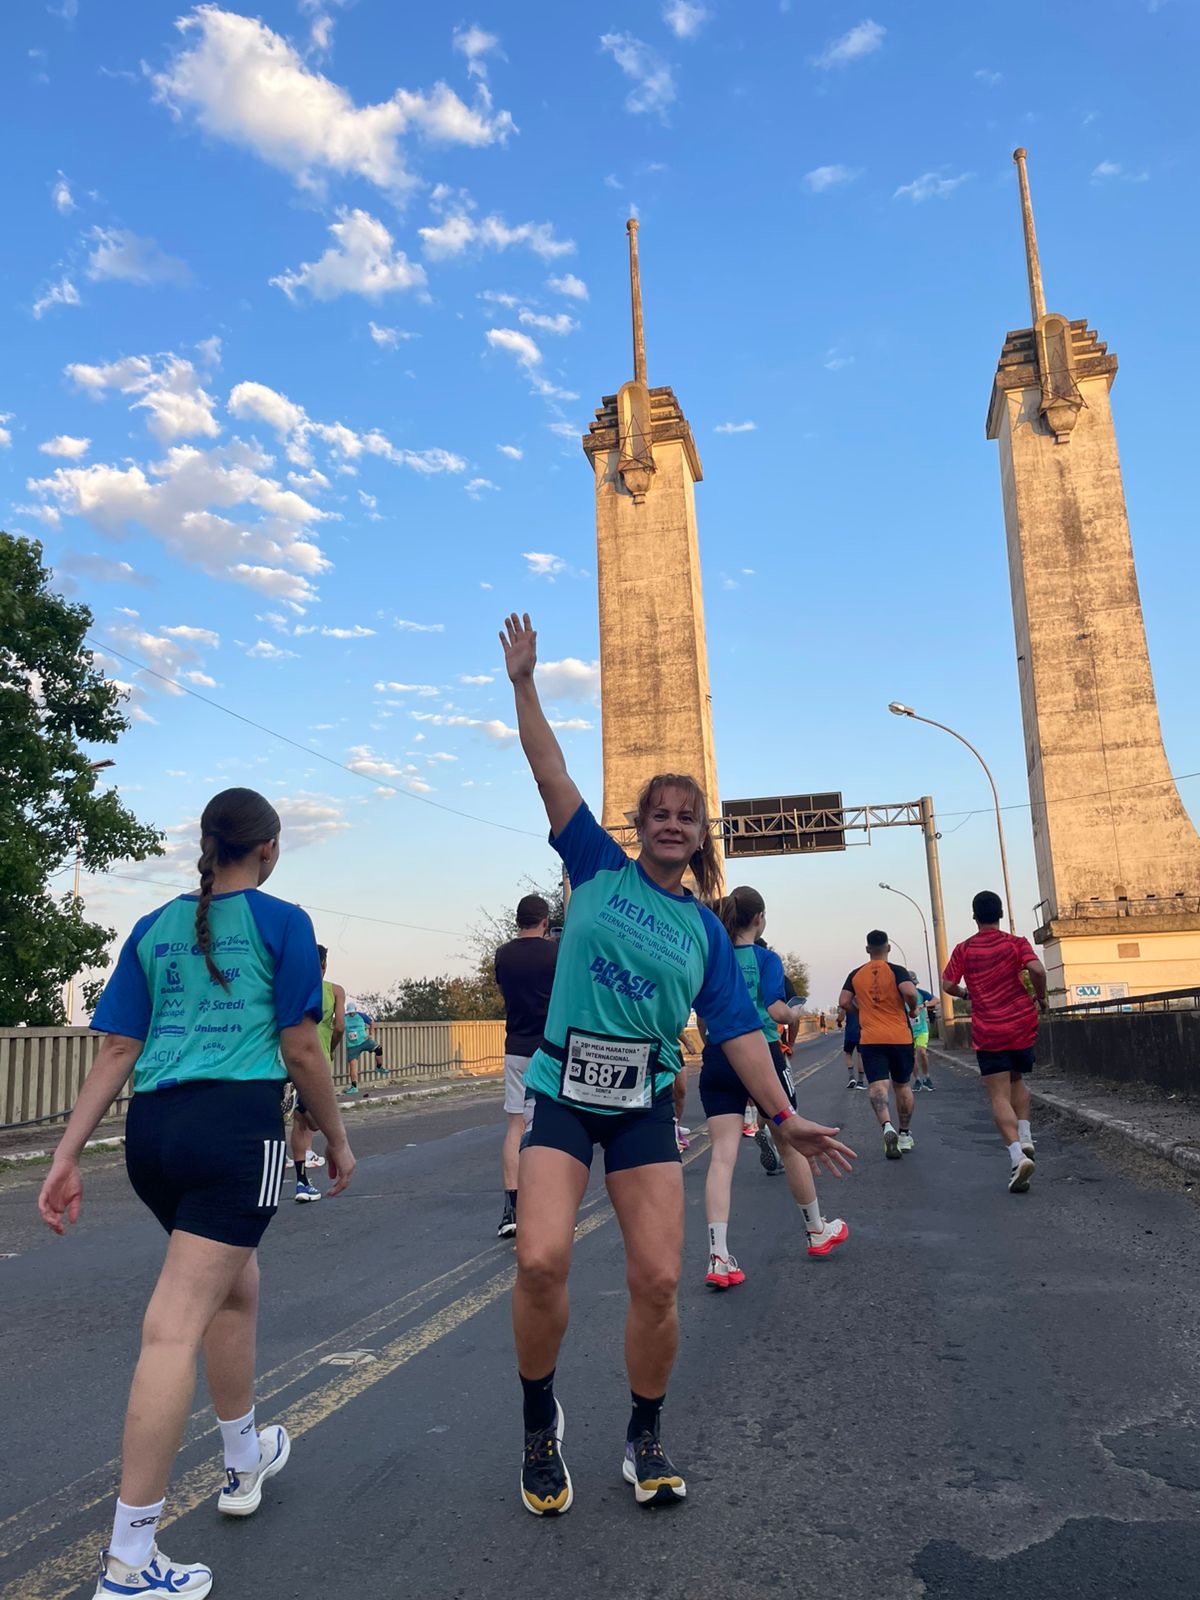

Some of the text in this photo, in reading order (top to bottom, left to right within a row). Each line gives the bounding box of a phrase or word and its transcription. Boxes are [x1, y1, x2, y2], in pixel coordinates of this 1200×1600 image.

[607, 894, 655, 932] MEIA
[598, 911, 687, 968] INTERNACIONAL URUGUAIANA
[656, 926, 678, 945] TONA
[170, 942, 188, 952] CDL
[590, 955, 657, 1000] BRASIL
[592, 973, 644, 1002] FREE SHOP
[1076, 986, 1100, 995] CVV
[194, 1024, 228, 1033] Unimed
[585, 1051, 630, 1062] INTERNACIONAL
[606, 1046, 637, 1054] MARATONA
[571, 1065, 579, 1074] 5K
[584, 1062, 627, 1089] 687
